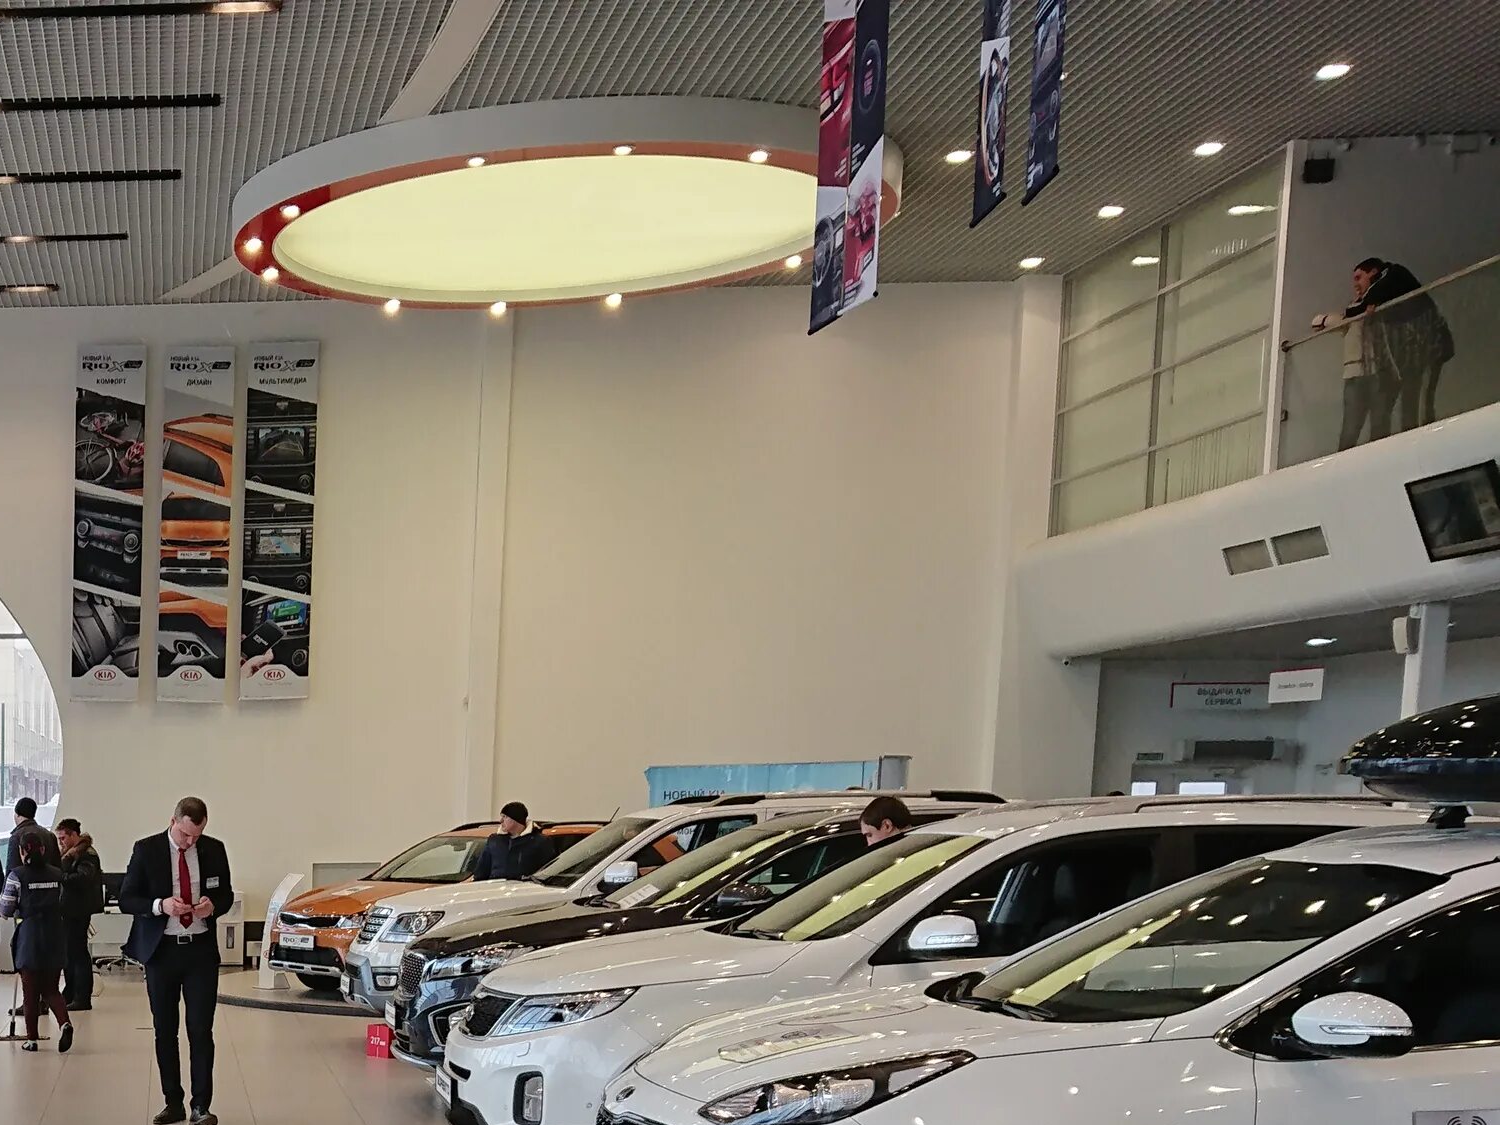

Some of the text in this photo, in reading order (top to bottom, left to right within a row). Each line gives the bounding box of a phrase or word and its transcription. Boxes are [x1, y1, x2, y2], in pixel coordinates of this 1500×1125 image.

[186, 378, 212, 386] ДИЗАЙН
[259, 377, 307, 386] МУЛЬТИМЕДИА
[1197, 688, 1234, 696] ВЫДАЧА
[1204, 698, 1242, 706] СЕРВИСА
[663, 788, 705, 800] НОВЫЙ
[370, 1036, 380, 1045] 217
